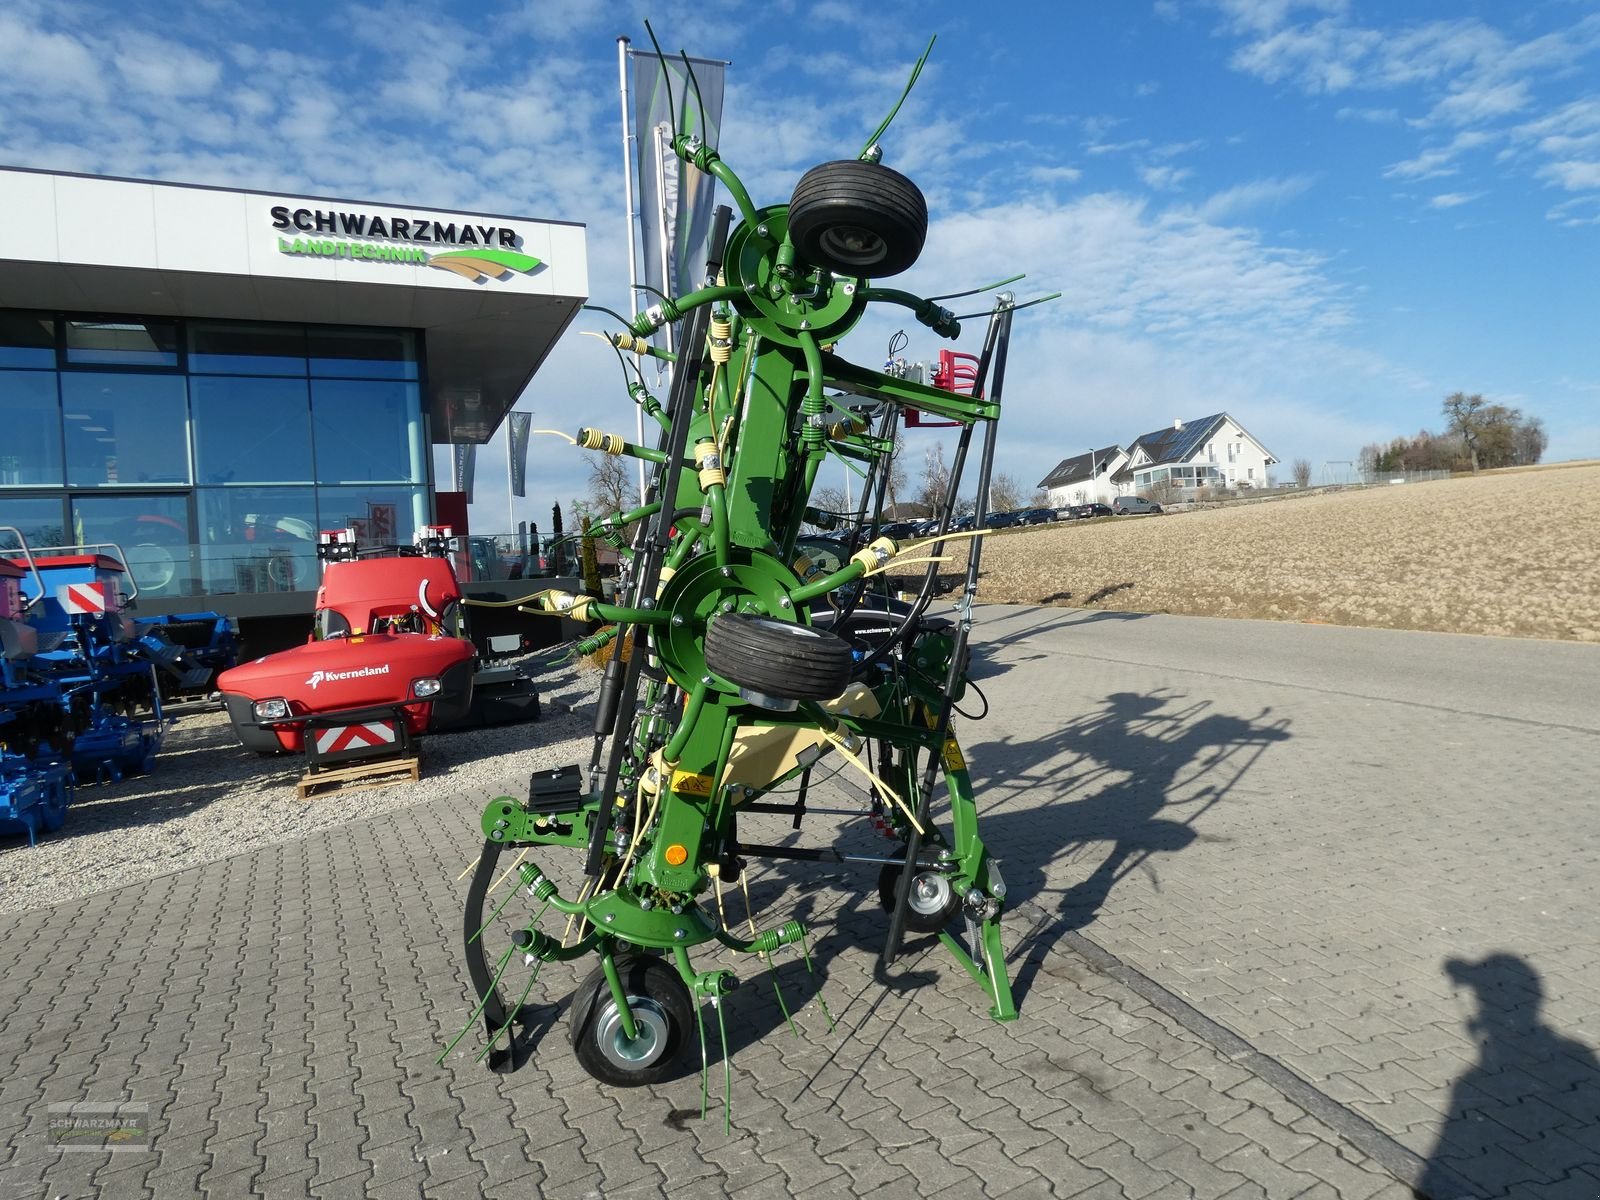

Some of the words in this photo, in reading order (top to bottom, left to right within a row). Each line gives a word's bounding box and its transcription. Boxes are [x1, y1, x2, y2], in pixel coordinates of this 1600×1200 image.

[270, 206, 517, 248] SCHWARZMAYR
[278, 237, 426, 263] LANDTECHNIK
[325, 664, 390, 681] Kverneland
